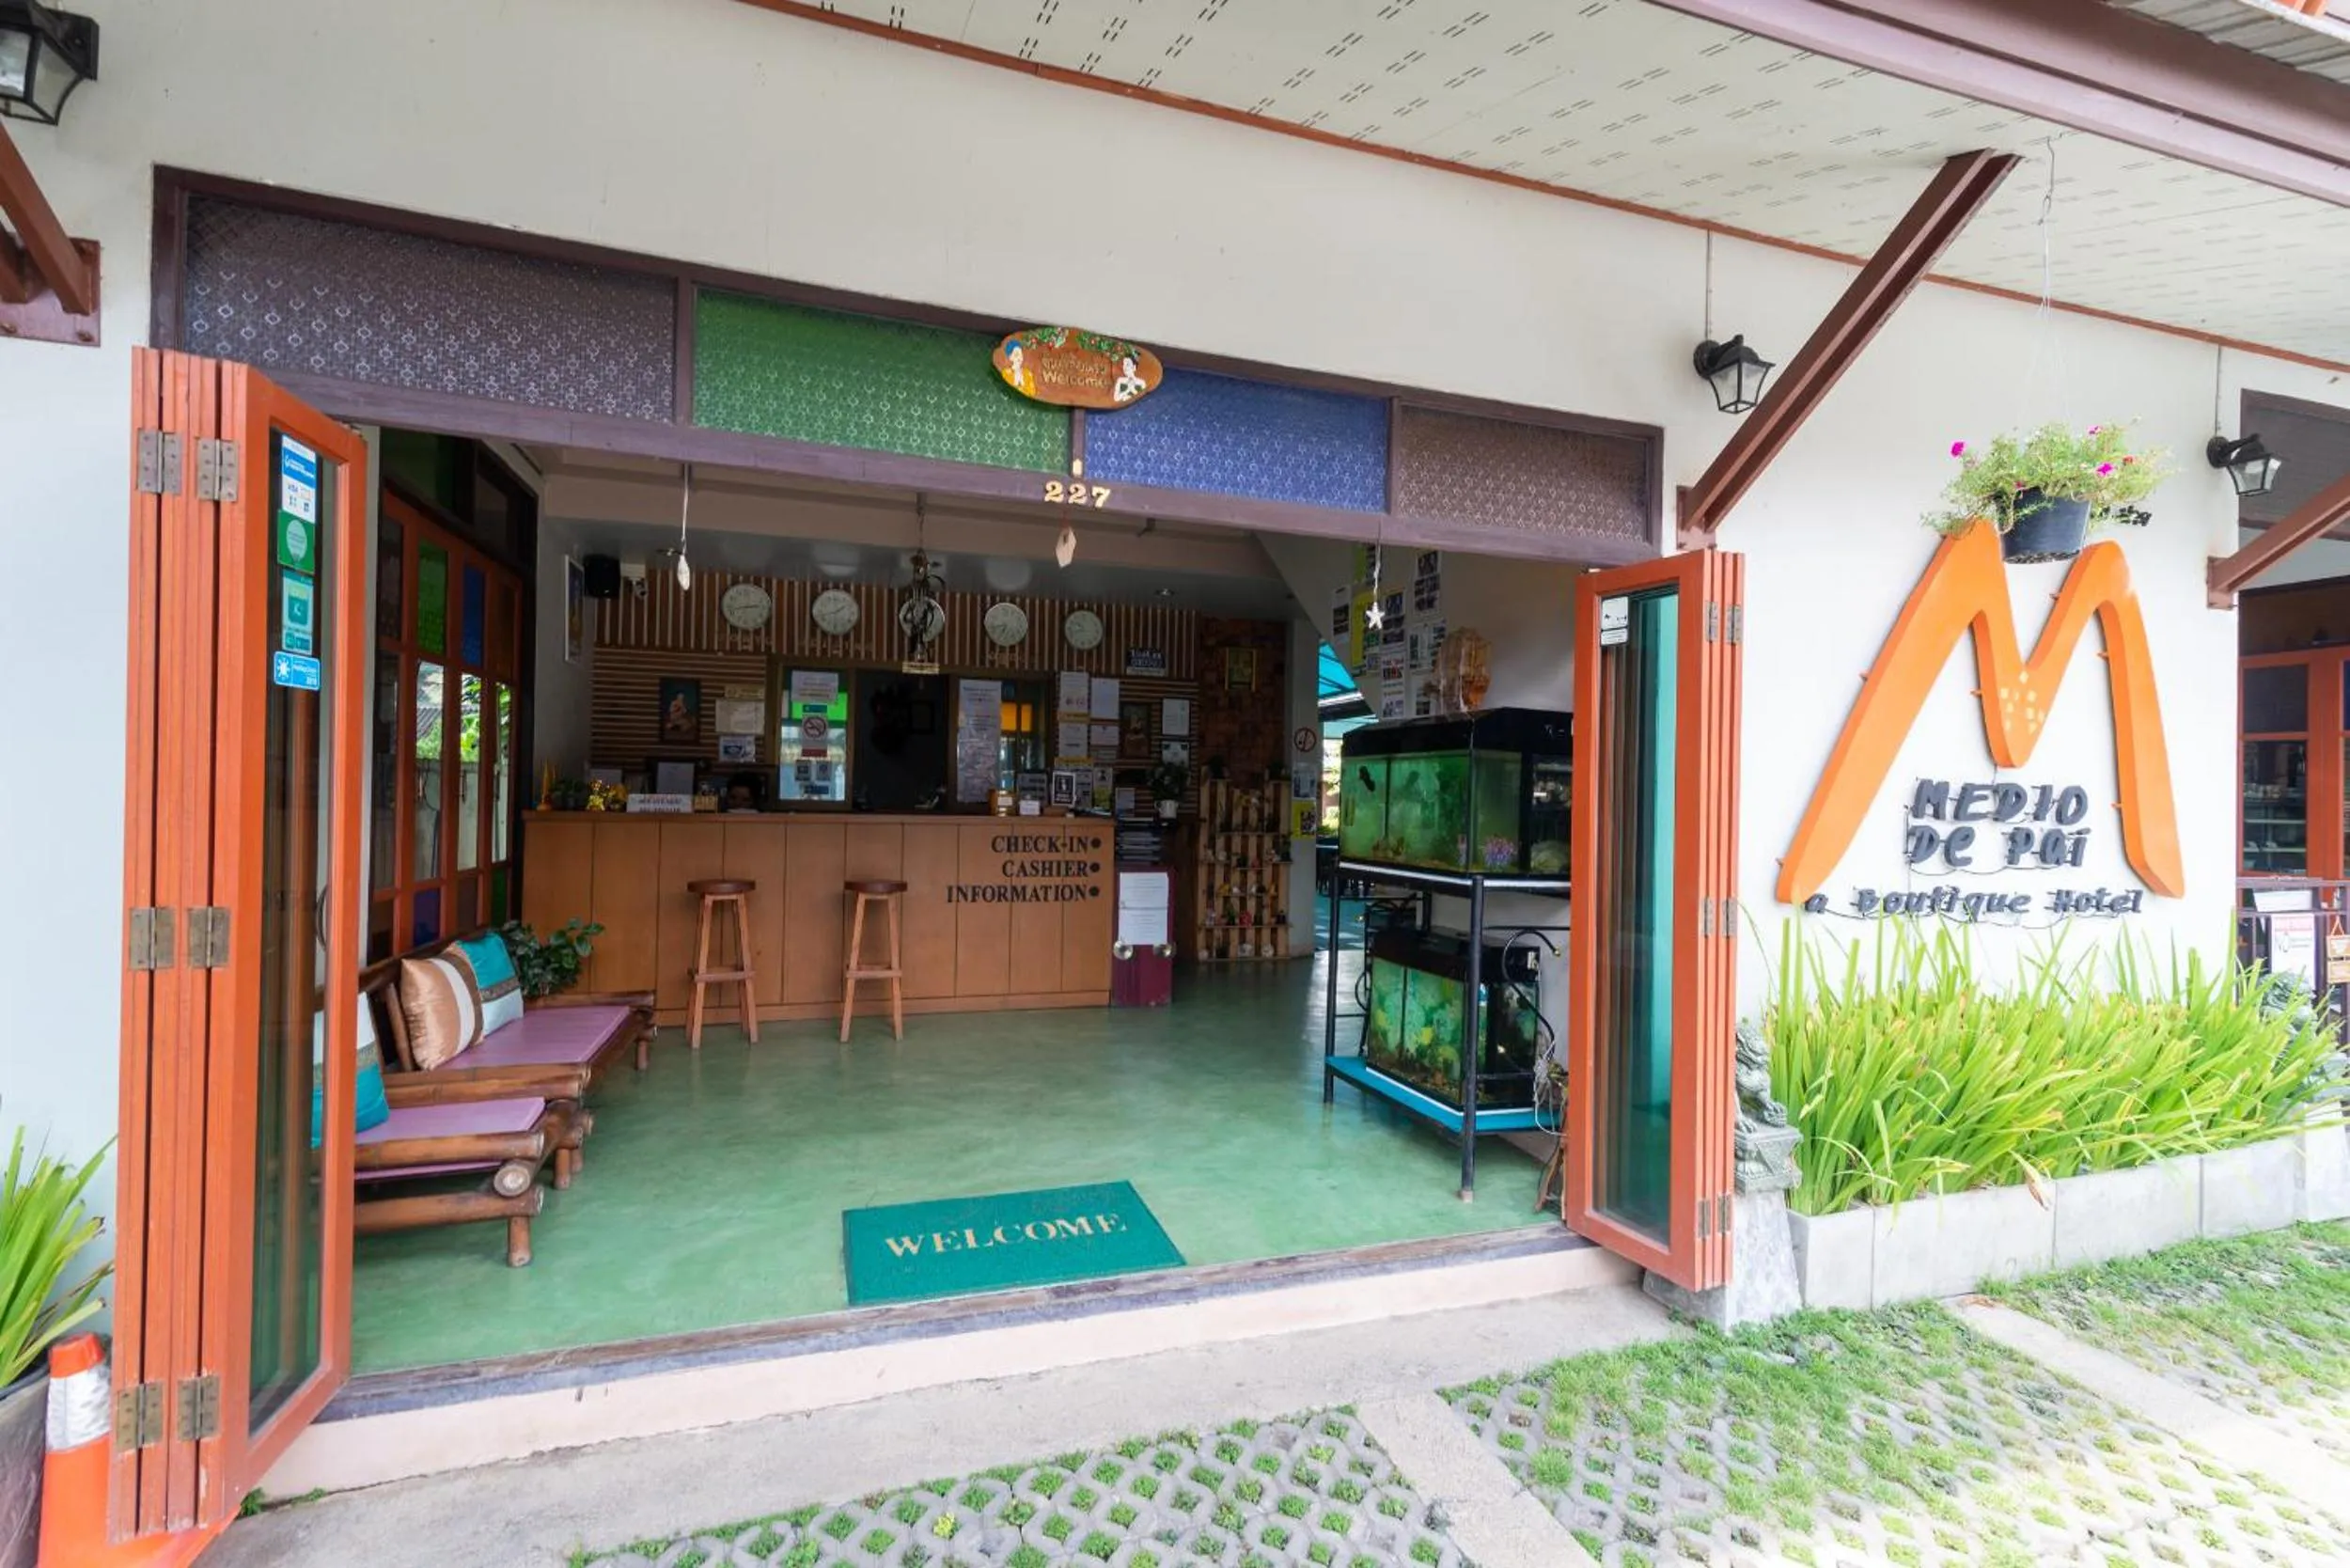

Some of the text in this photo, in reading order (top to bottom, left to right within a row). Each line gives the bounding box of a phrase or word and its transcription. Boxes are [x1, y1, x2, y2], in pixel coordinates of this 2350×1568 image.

[1042, 369, 1110, 388] Welcome
[1044, 480, 1111, 509] 227
[1911, 778, 2089, 825] MEDIO
[991, 835, 1090, 855] CHECK-IN
[1001, 859, 1089, 879] CASHIER
[946, 885, 1088, 903] INFORMATION
[1804, 892, 1829, 914] a
[2049, 887, 2144, 915] Hotel
[885, 1214, 1128, 1258] WELCOME
